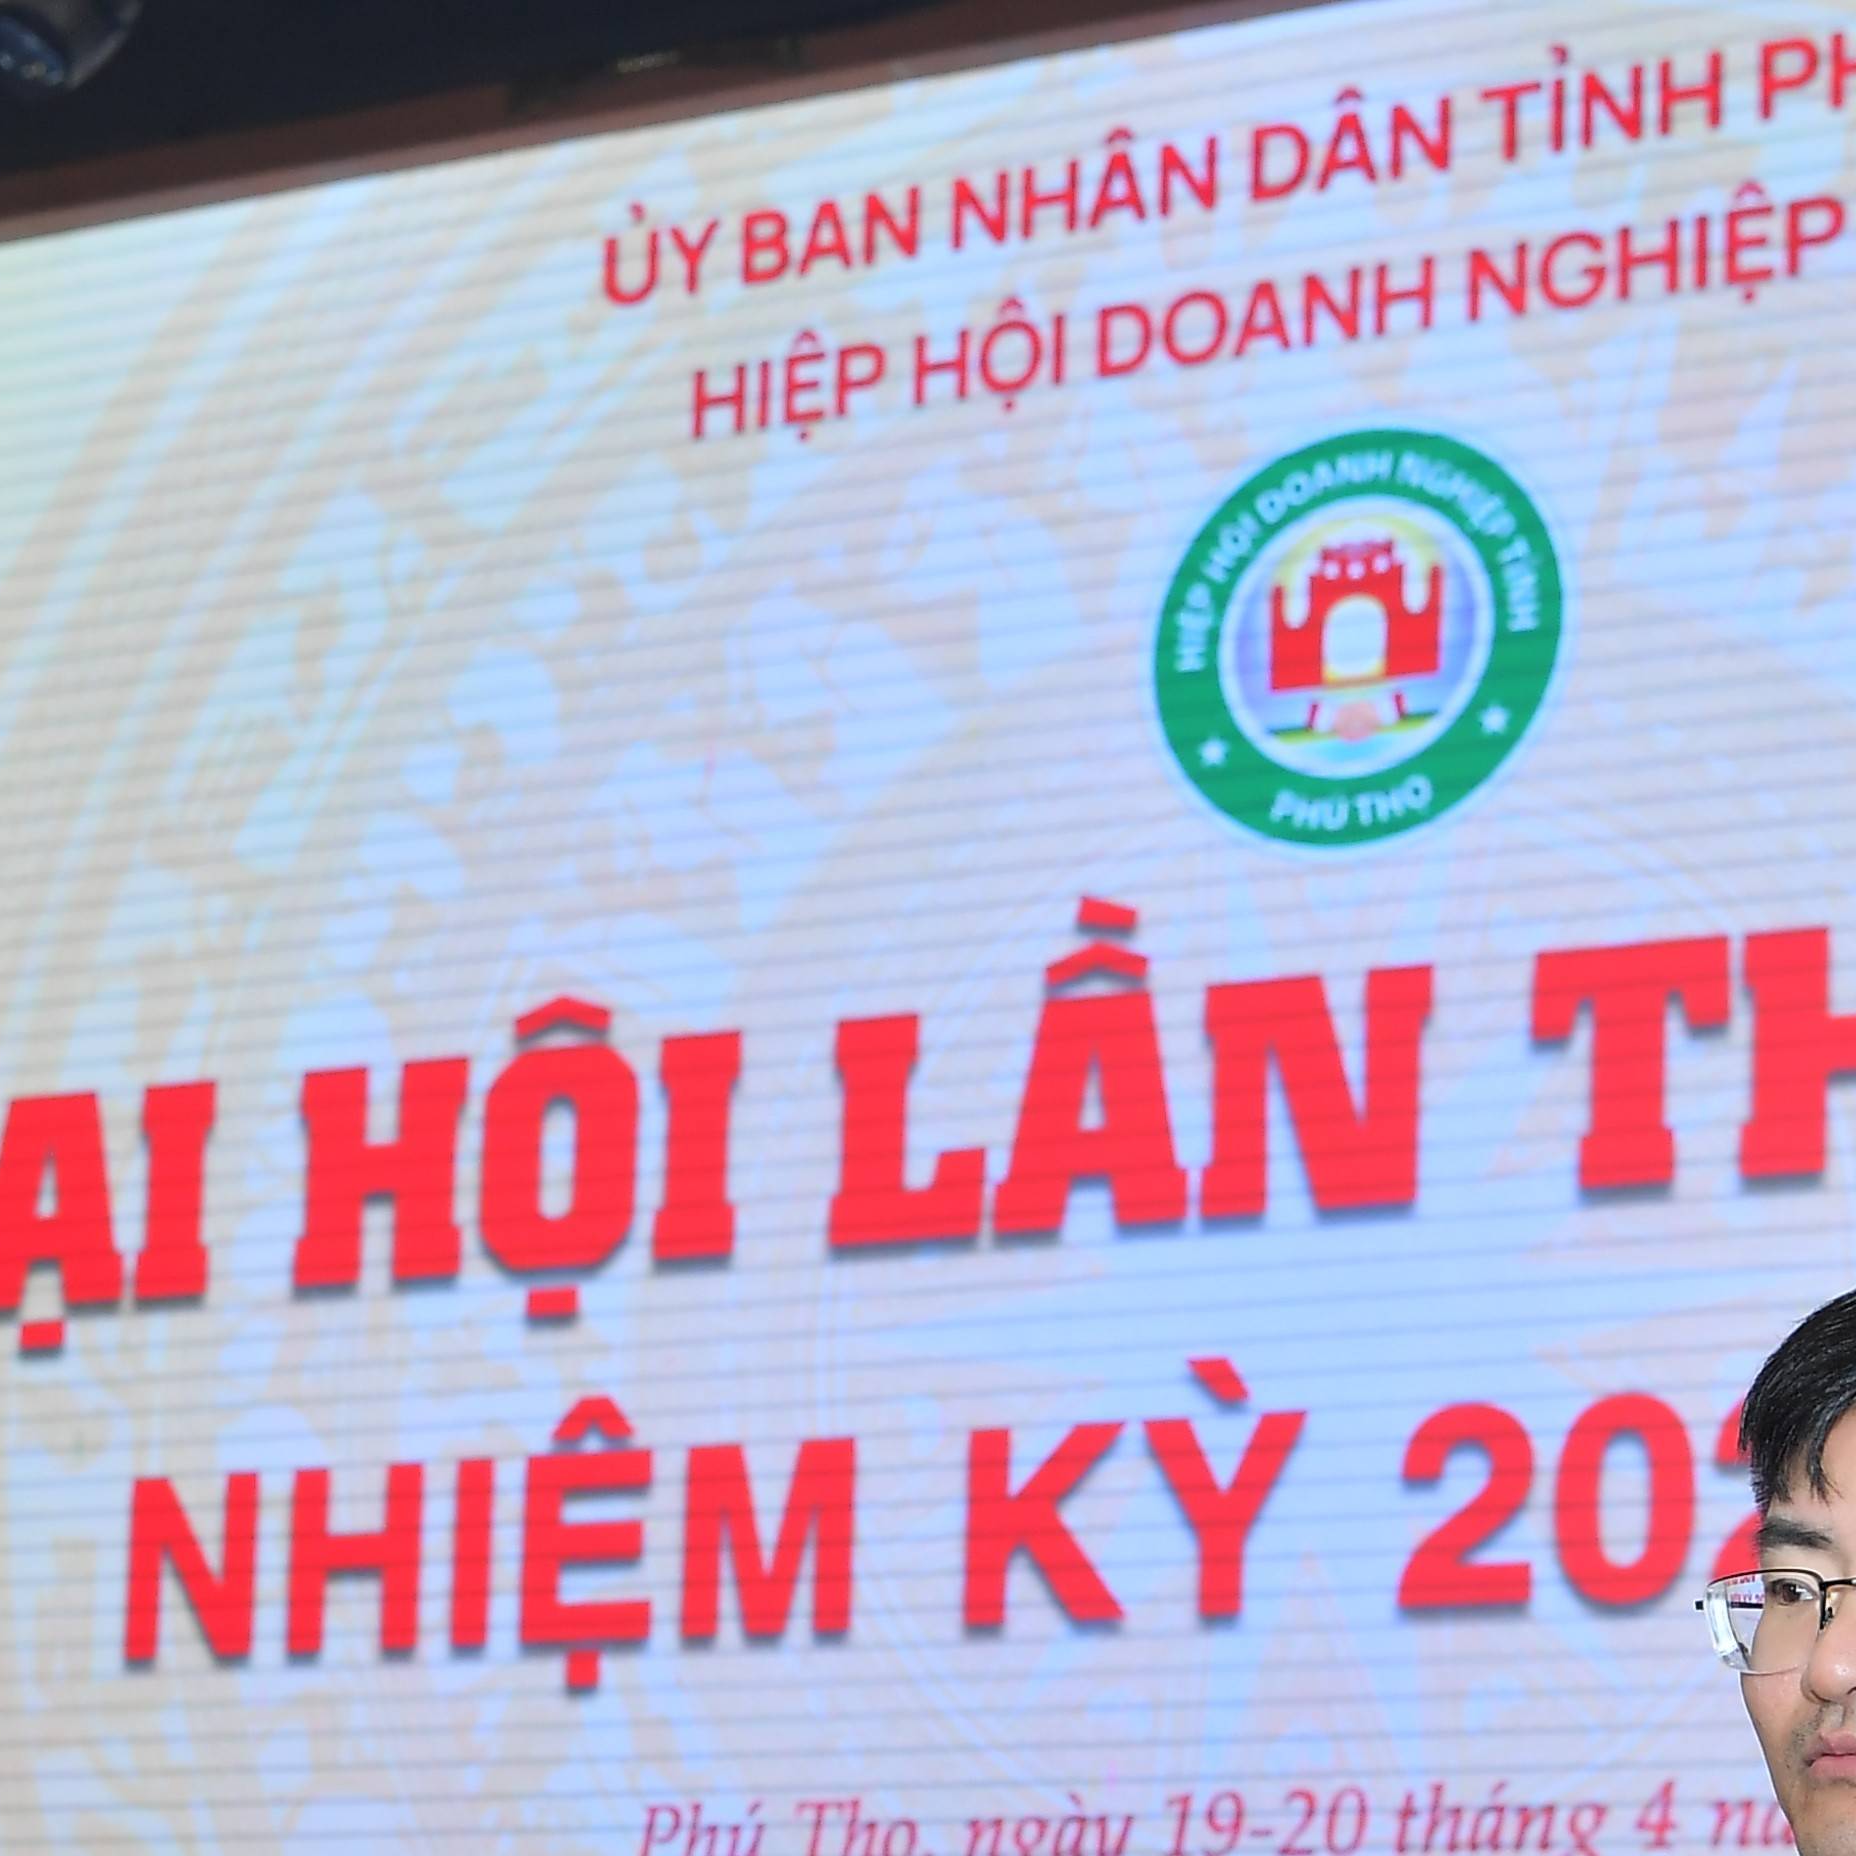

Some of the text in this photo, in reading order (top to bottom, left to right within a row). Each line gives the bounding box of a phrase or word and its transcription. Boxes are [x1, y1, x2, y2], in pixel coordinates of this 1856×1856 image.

[604, 205, 716, 304] ỦY
[742, 187, 920, 283] BAN
[952, 128, 1216, 246] NHÂN
[1252, 90, 1451, 201] DÂN
[1489, 52, 1722, 160] TỈNH
[694, 332, 886, 435] HIỆP
[915, 299, 1064, 402] HỘI
[1097, 257, 1434, 376] DOANH
[1469, 184, 1844, 317] NGHIỆP
[294, 998, 742, 1314] HỘI
[828, 897, 1434, 1250] LẦN
[125, 1399, 856, 1687] NHIỆM
[964, 1359, 1304, 1625] KỲ
[1636, 1781, 1676, 1849] 4
